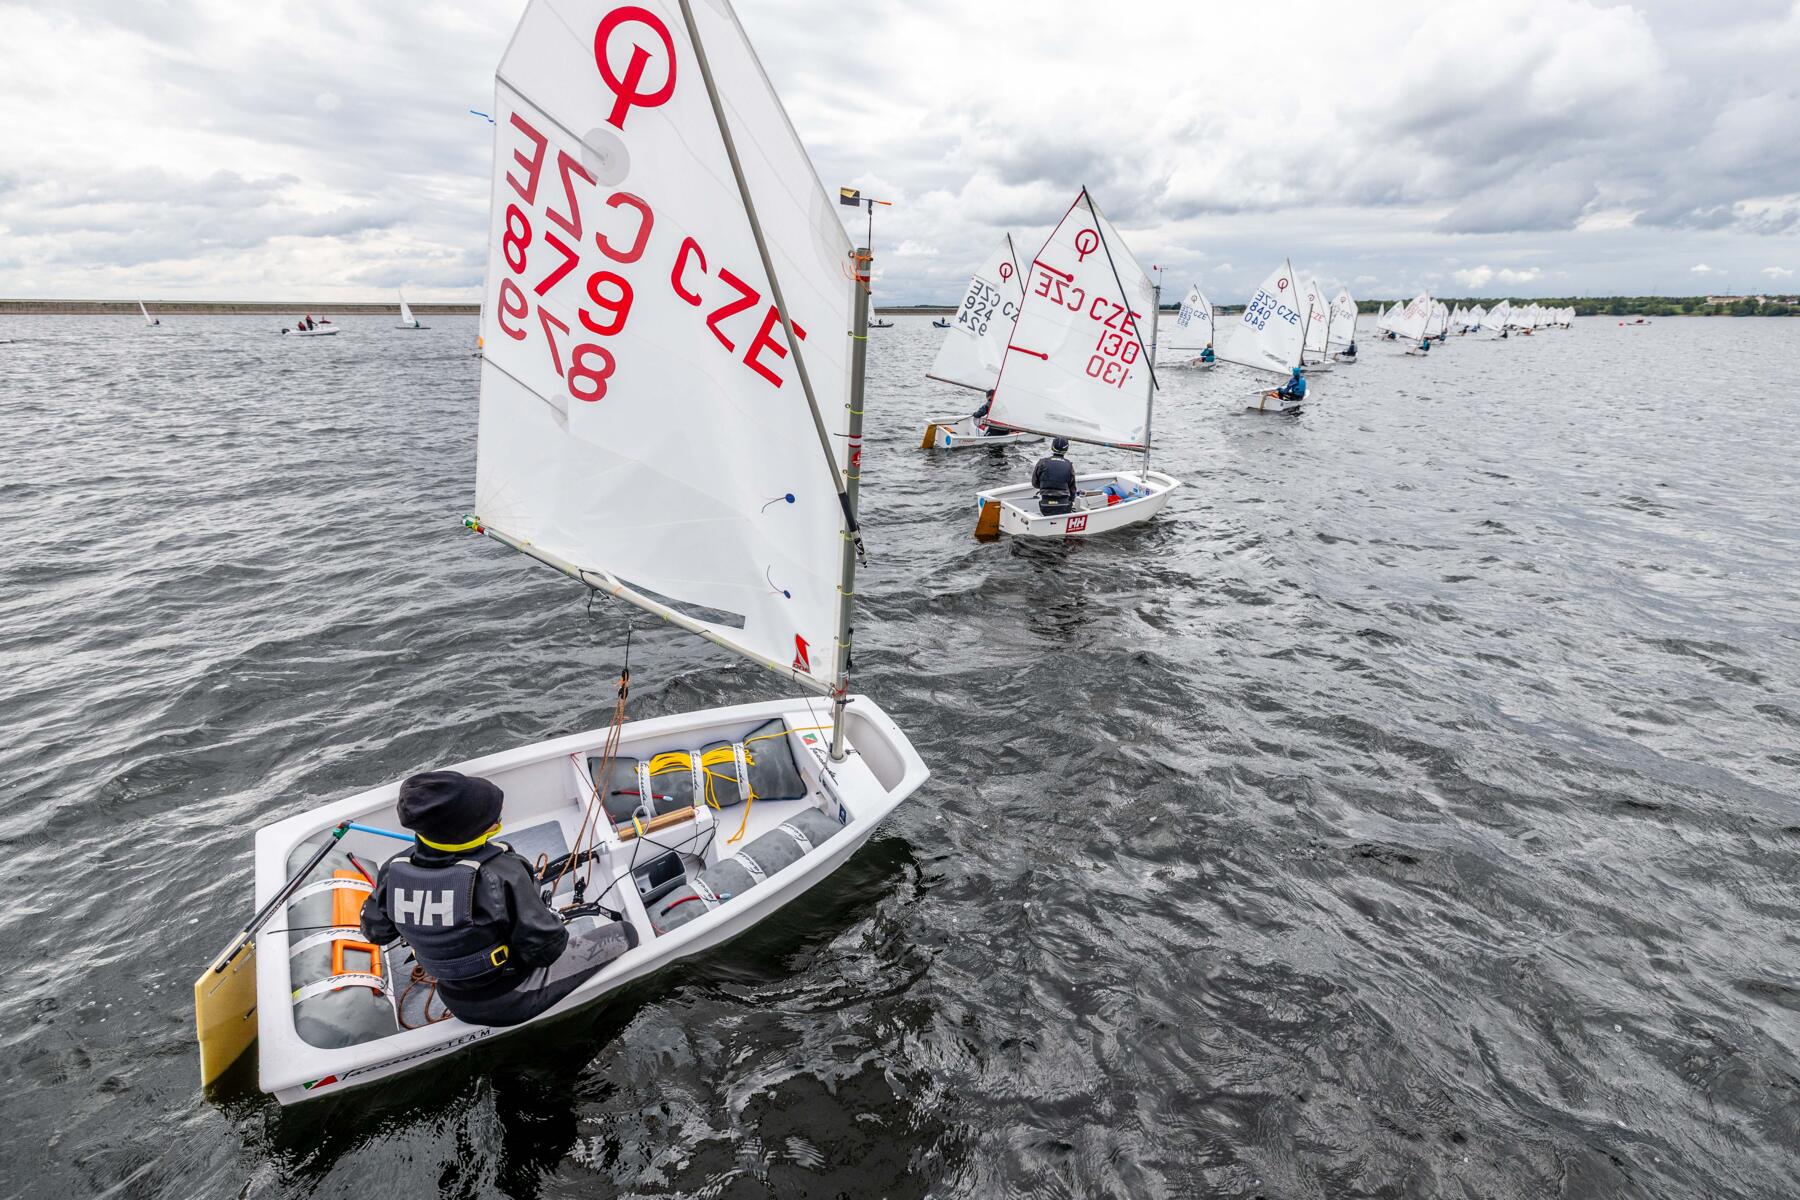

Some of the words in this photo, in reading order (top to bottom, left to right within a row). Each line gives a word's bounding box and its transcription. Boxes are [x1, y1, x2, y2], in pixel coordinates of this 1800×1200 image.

[503, 203, 634, 337] 879
[671, 236, 807, 389] CZE
[965, 295, 993, 323] 924
[1089, 297, 1143, 337] CZE
[1193, 310, 1209, 321] CZE
[1250, 301, 1271, 320] 840
[1277, 305, 1301, 326] CZE
[1095, 330, 1141, 365] 130
[1068, 516, 1086, 529] HH
[394, 887, 455, 927] HH
